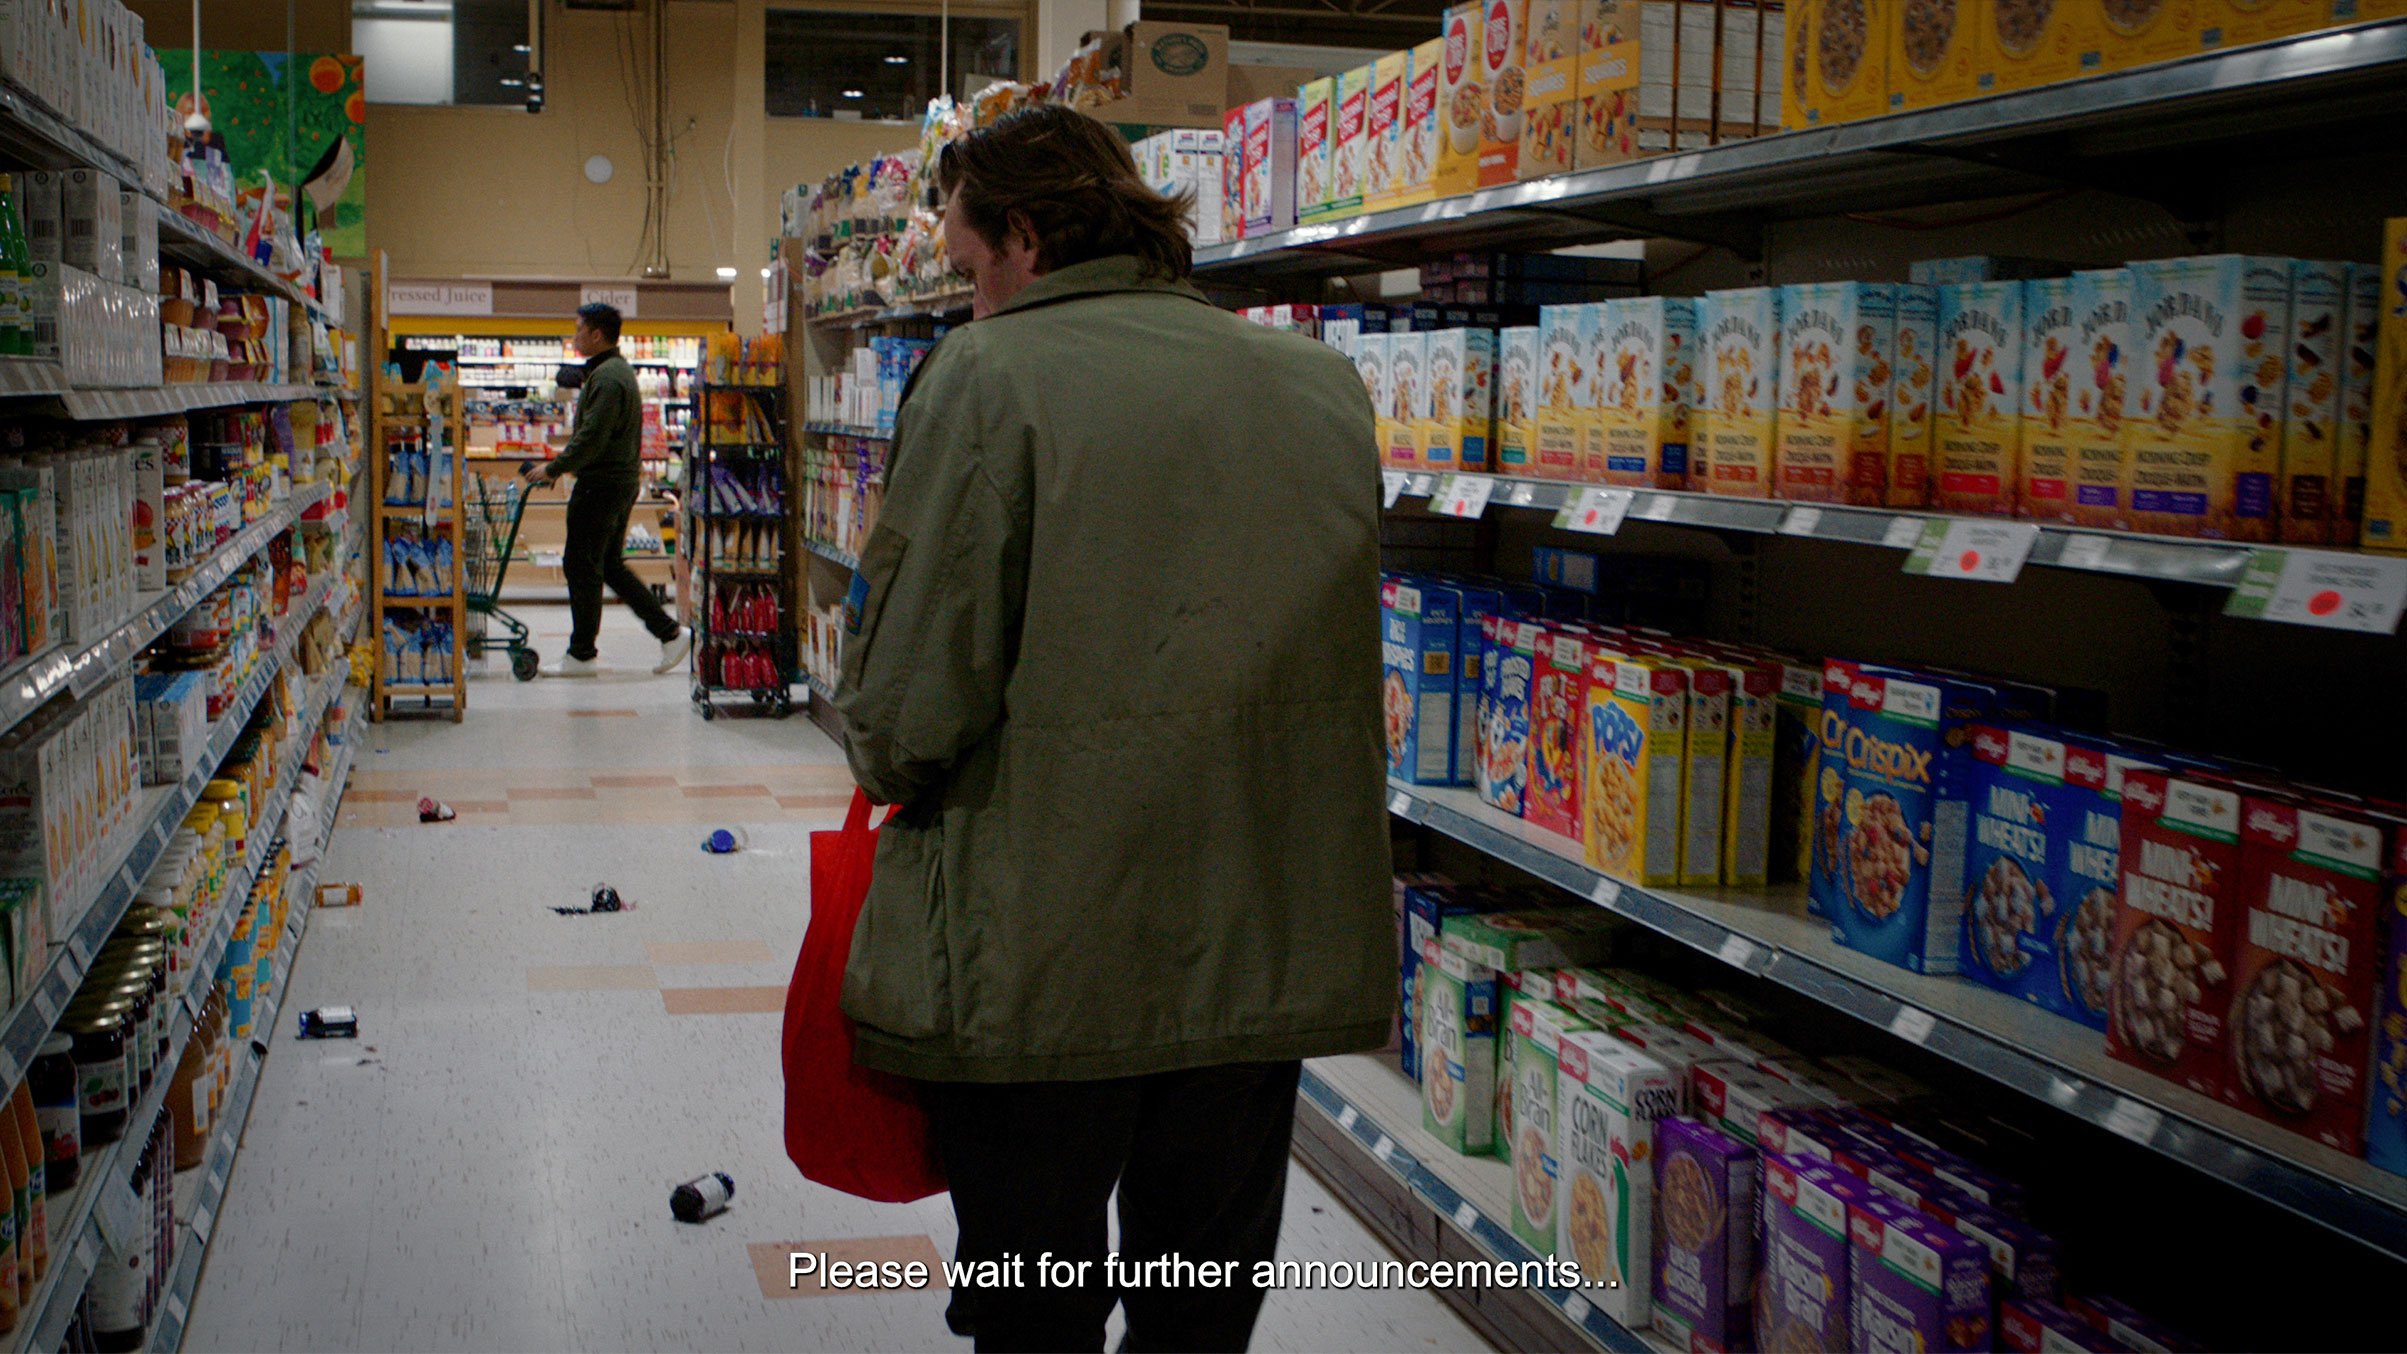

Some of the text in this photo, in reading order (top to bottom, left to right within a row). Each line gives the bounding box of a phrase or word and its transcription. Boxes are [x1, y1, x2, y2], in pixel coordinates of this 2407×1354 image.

[390, 287, 486, 305] ressed Juice
[587, 289, 630, 304] Cider
[1845, 725, 1934, 785] Crispix
[1975, 812, 2047, 865] WHEATS!
[2123, 870, 2216, 934] WHEATS!
[2247, 905, 2351, 978] WHEATS!
[1572, 1094, 1608, 1151] CORN
[1571, 1129, 1608, 1180] FLAKES
